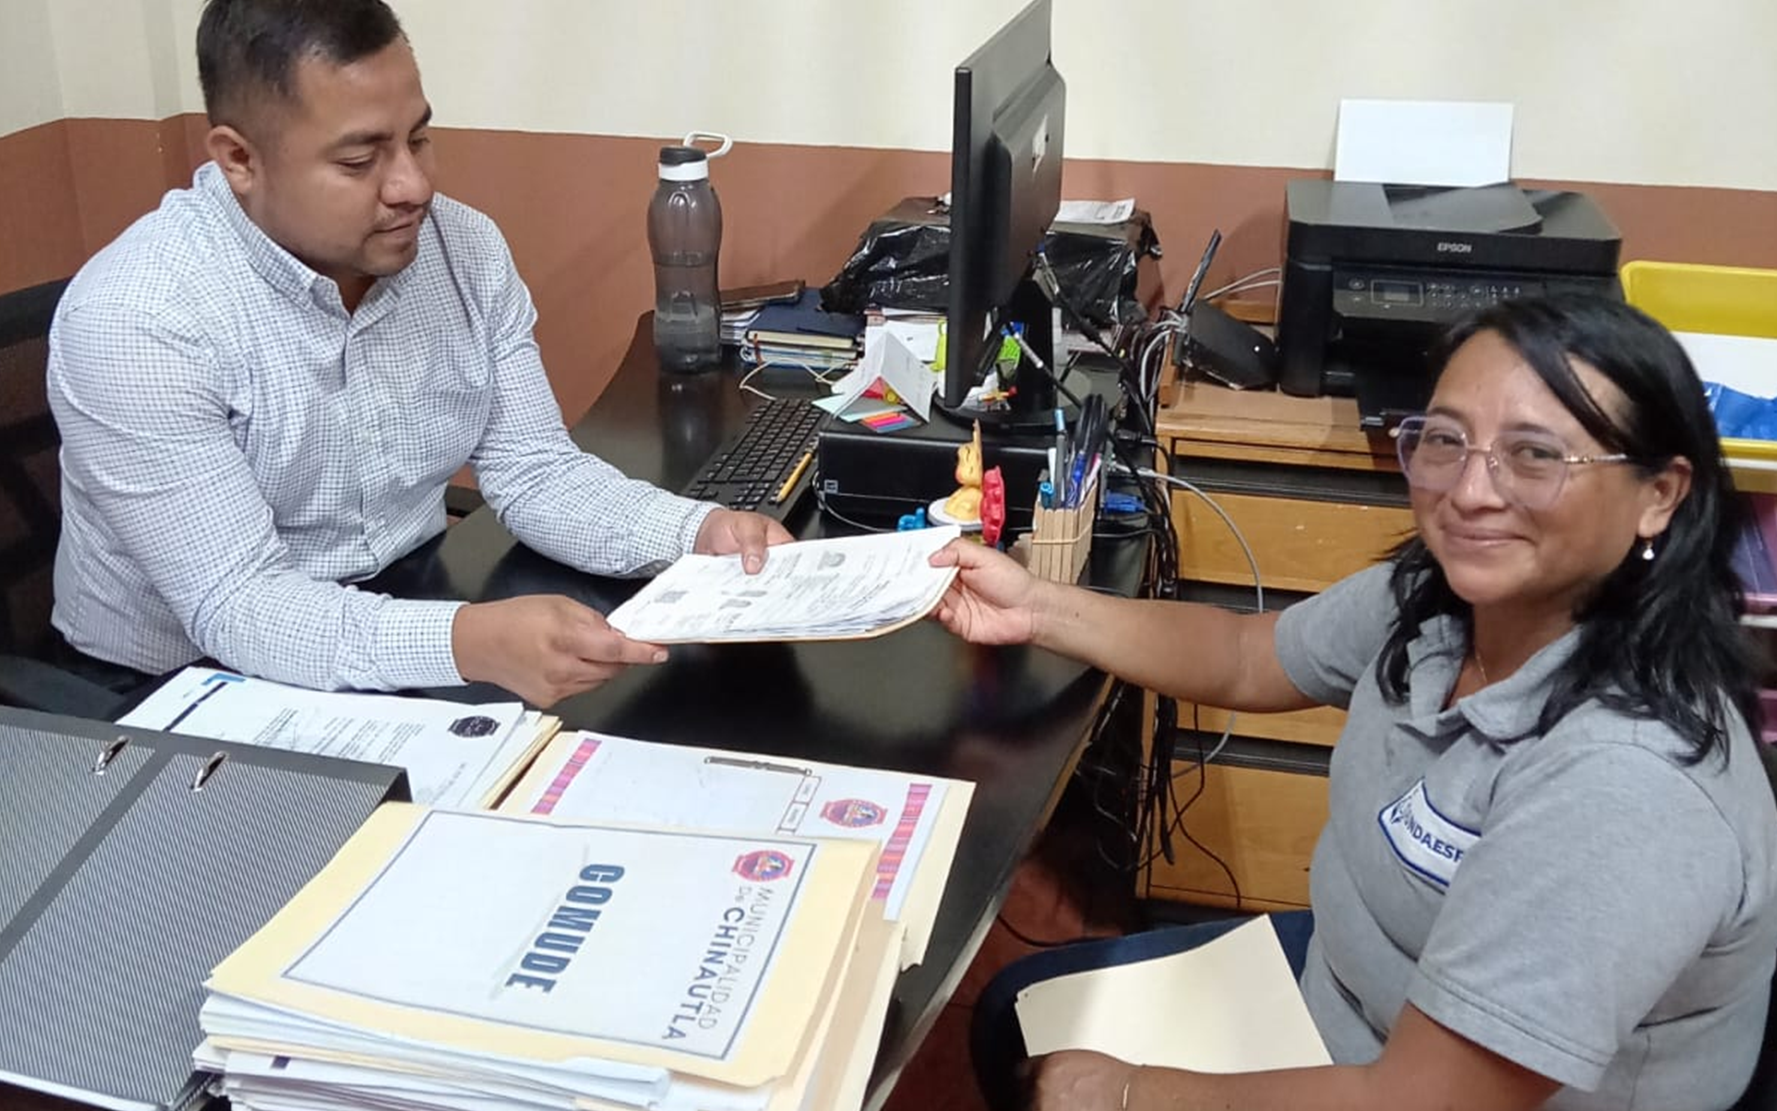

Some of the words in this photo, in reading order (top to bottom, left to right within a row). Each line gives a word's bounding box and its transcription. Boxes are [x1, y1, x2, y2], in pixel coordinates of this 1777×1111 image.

[1437, 242, 1472, 253] EPSON
[505, 864, 625, 993] COMUDE
[661, 907, 745, 1040] CHINAUTLA
[699, 886, 774, 1030] MUNICIPALIDAD
